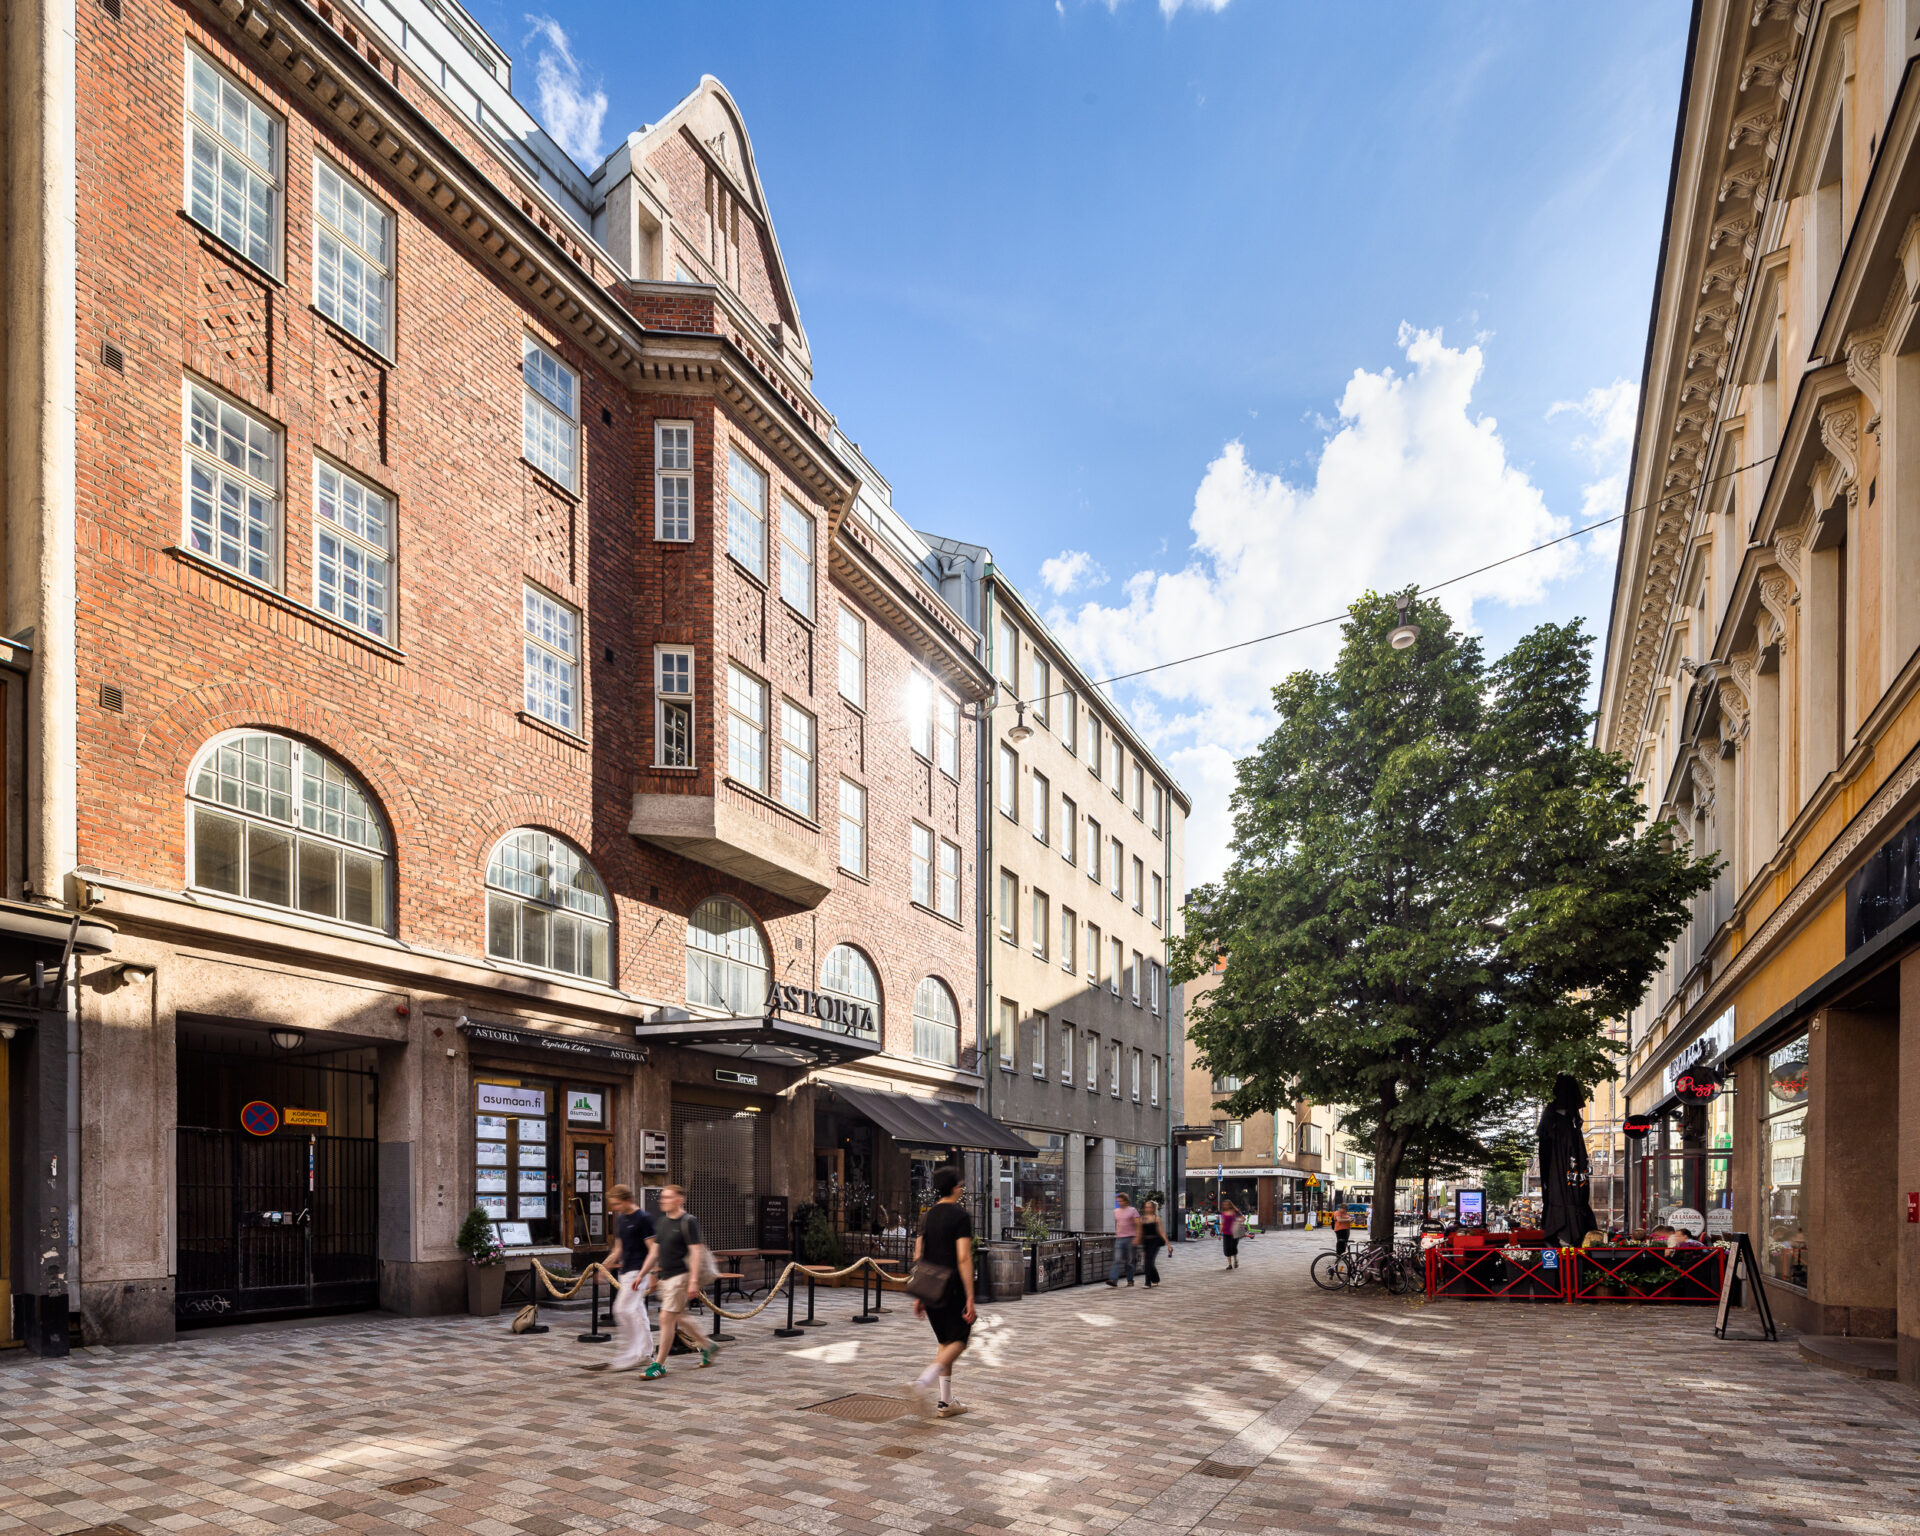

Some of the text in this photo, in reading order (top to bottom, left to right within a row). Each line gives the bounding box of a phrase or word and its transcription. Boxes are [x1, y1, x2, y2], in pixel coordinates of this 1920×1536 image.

[764, 981, 877, 1032] ASTORIA
[475, 1028, 520, 1043] ASTORIA
[610, 1050, 646, 1062] ASTORIA
[1677, 1076, 1721, 1098] Pizza
[483, 1094, 541, 1109] asumaan.fi
